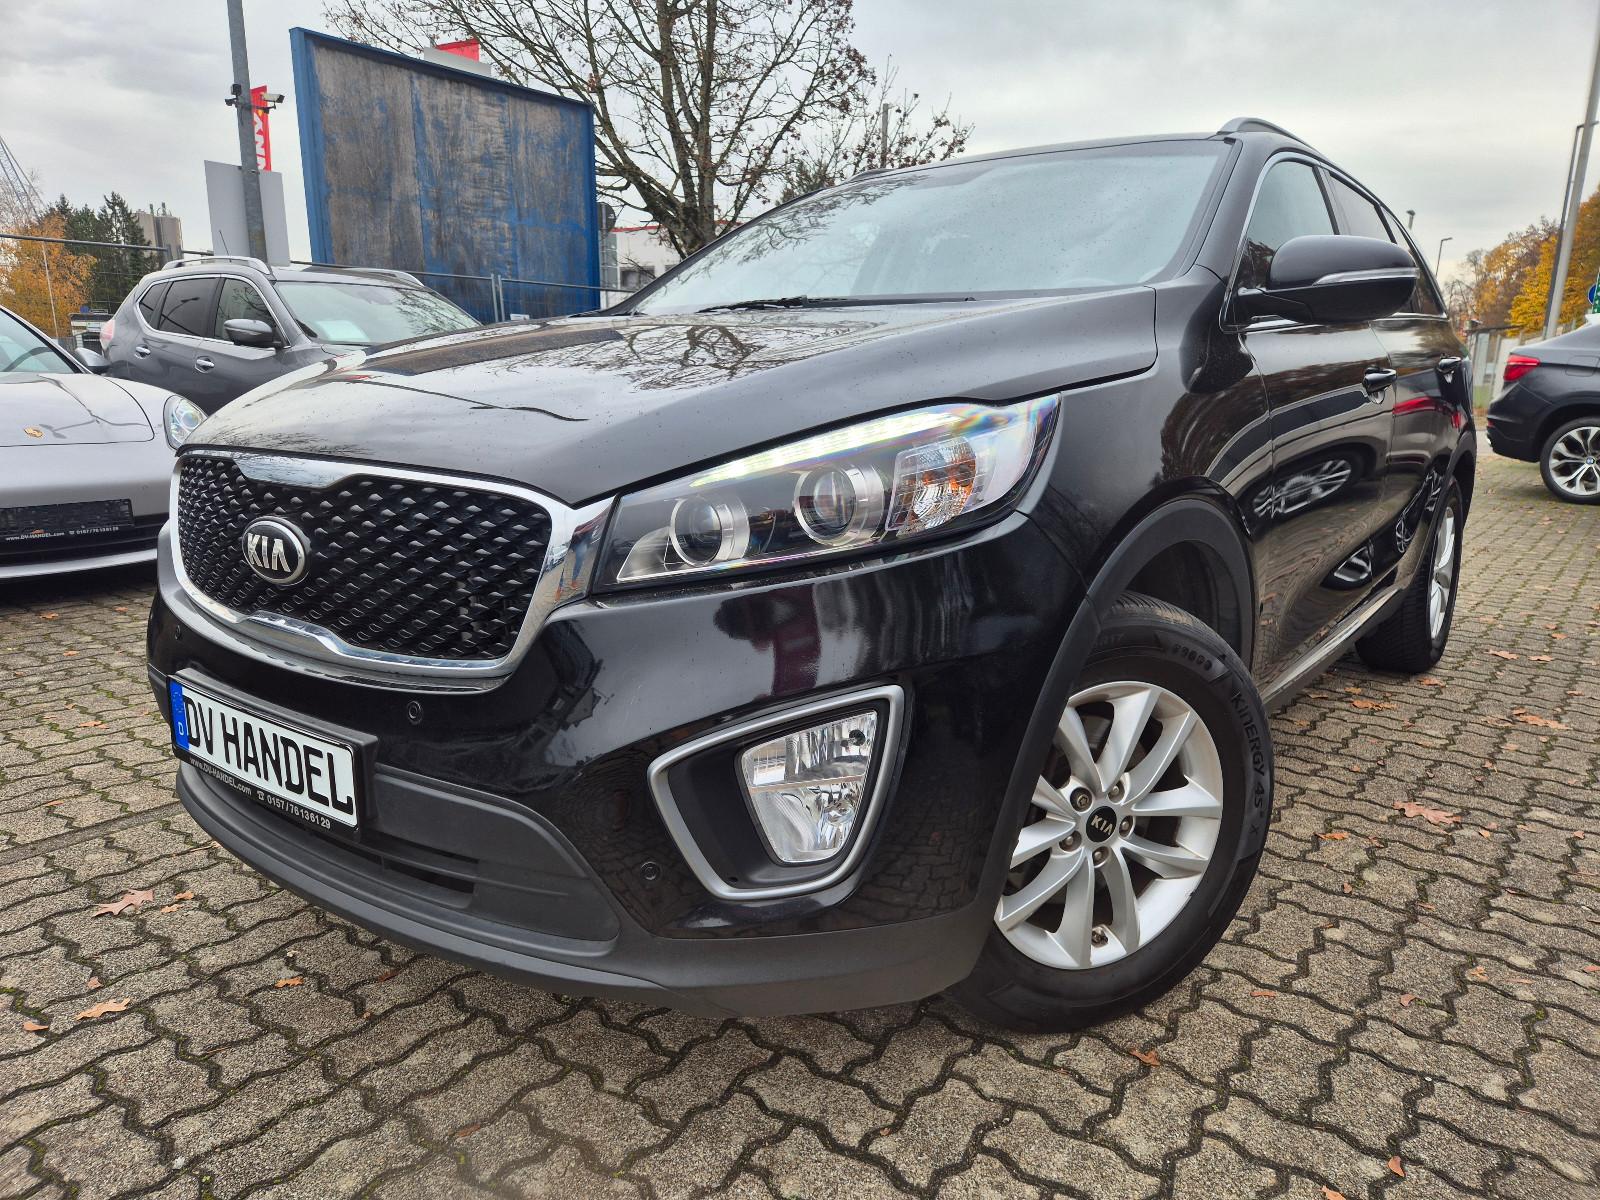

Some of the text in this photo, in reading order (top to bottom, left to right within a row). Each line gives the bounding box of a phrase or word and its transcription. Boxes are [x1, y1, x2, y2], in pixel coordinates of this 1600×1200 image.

[247, 532, 292, 573] KIA
[178, 721, 185, 736] D
[182, 694, 354, 816] DV HANDEL
[1090, 814, 1113, 836] KIA
